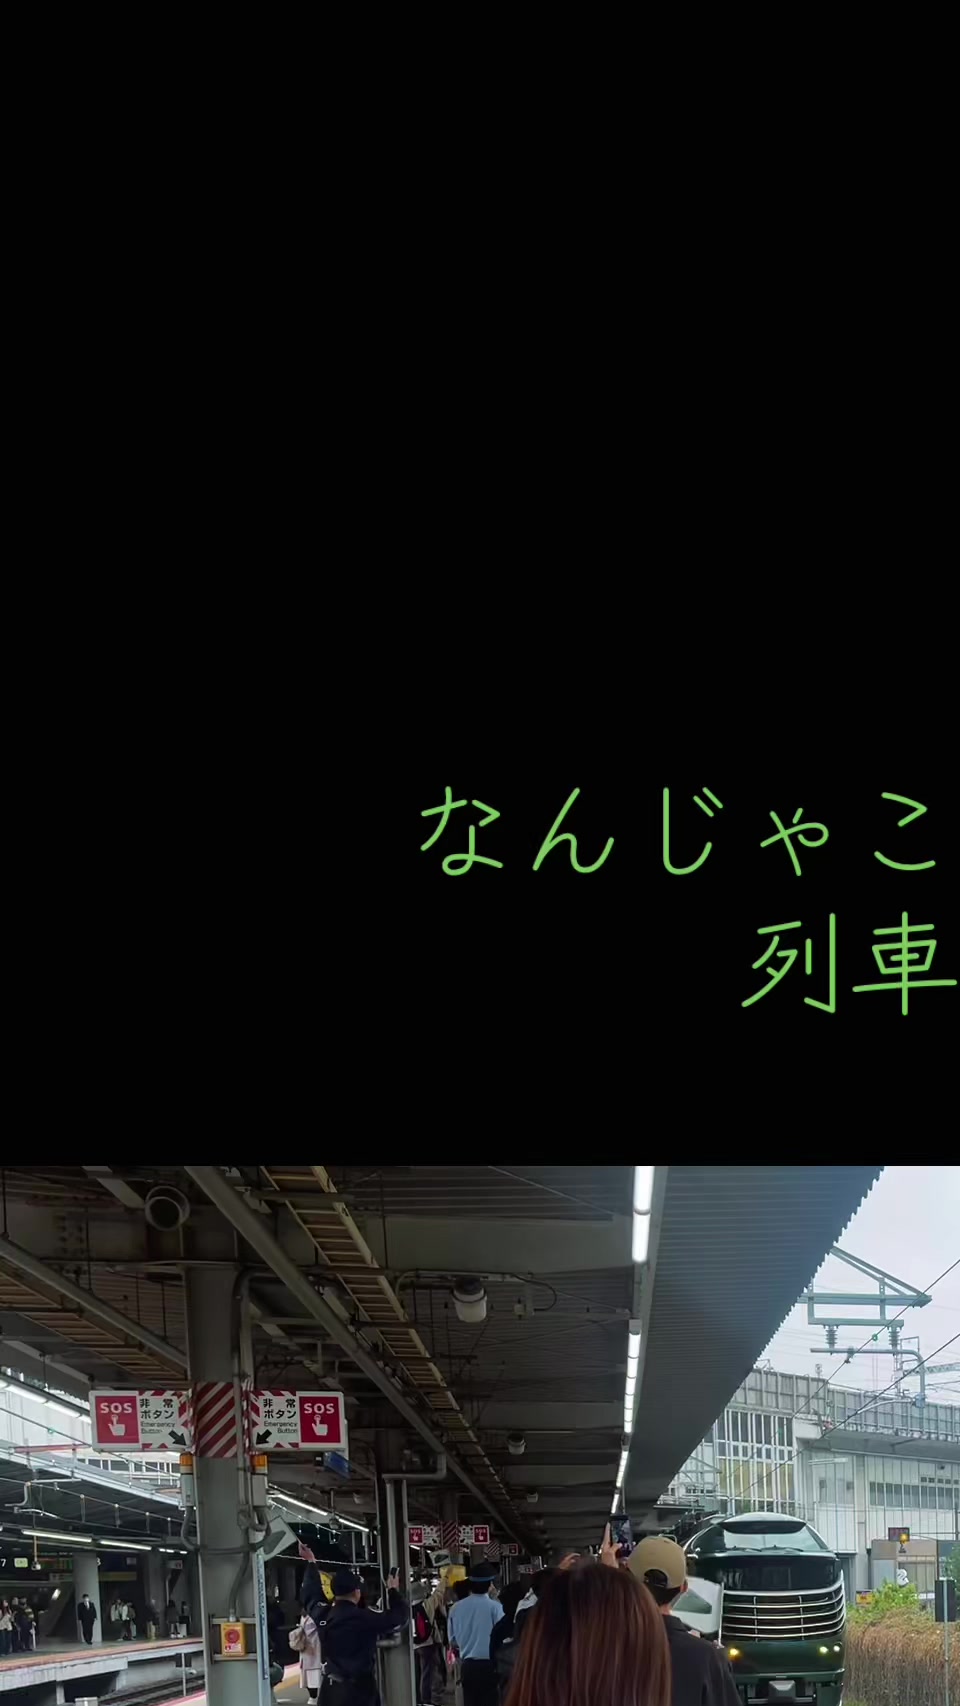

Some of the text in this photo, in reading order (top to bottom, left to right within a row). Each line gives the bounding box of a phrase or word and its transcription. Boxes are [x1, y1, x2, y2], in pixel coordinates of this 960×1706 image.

[100, 1402, 133, 1414] SOS
[140, 1399, 174, 1409] 非常
[263, 1399, 297, 1409] 非常
[303, 1402, 335, 1414] SOS
[140, 1410, 175, 1420] ボタン
[264, 1410, 297, 1420] ボタン
[140, 1421, 176, 1429] Emergency
